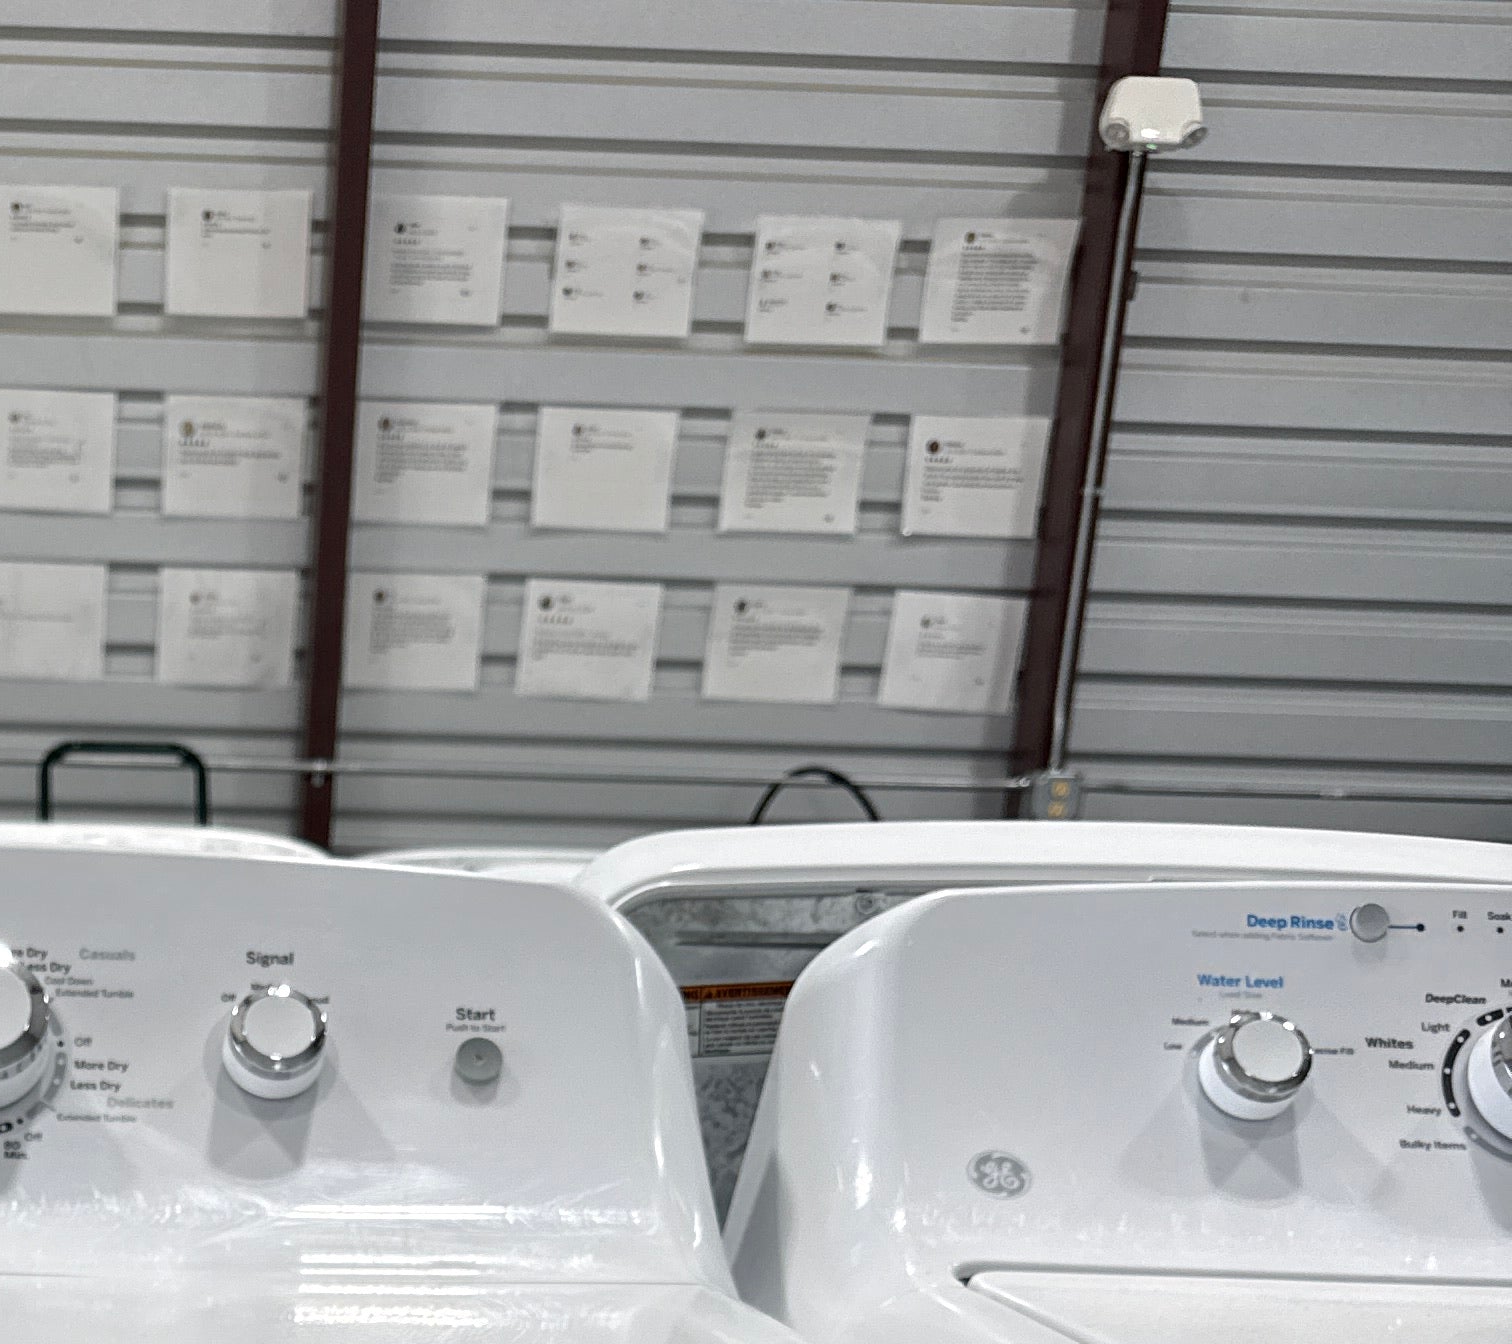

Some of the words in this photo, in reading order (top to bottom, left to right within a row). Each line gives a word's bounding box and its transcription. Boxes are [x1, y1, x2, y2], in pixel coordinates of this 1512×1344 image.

[1247, 914, 1287, 930] Deep
[1290, 916, 1334, 930] Rinse
[26, 947, 47, 960] Dry
[79, 948, 135, 961] Casuals
[246, 951, 294, 968] Signal
[50, 962, 71, 975] Dry
[1196, 974, 1240, 987] Water
[1244, 975, 1284, 989] Level
[1425, 993, 1487, 1005] DeepClean
[456, 1007, 496, 1022] Start
[1421, 1021, 1451, 1034] Light
[1365, 1037, 1414, 1050] Whites
[74, 1059, 105, 1071] More
[107, 1060, 129, 1074] Dry
[1388, 1060, 1435, 1071] Medium
[69, 1079, 98, 1091] Less
[99, 1080, 122, 1094] Dry
[107, 1096, 175, 1110] Delicates
[1406, 1105, 1443, 1118] Heavy
